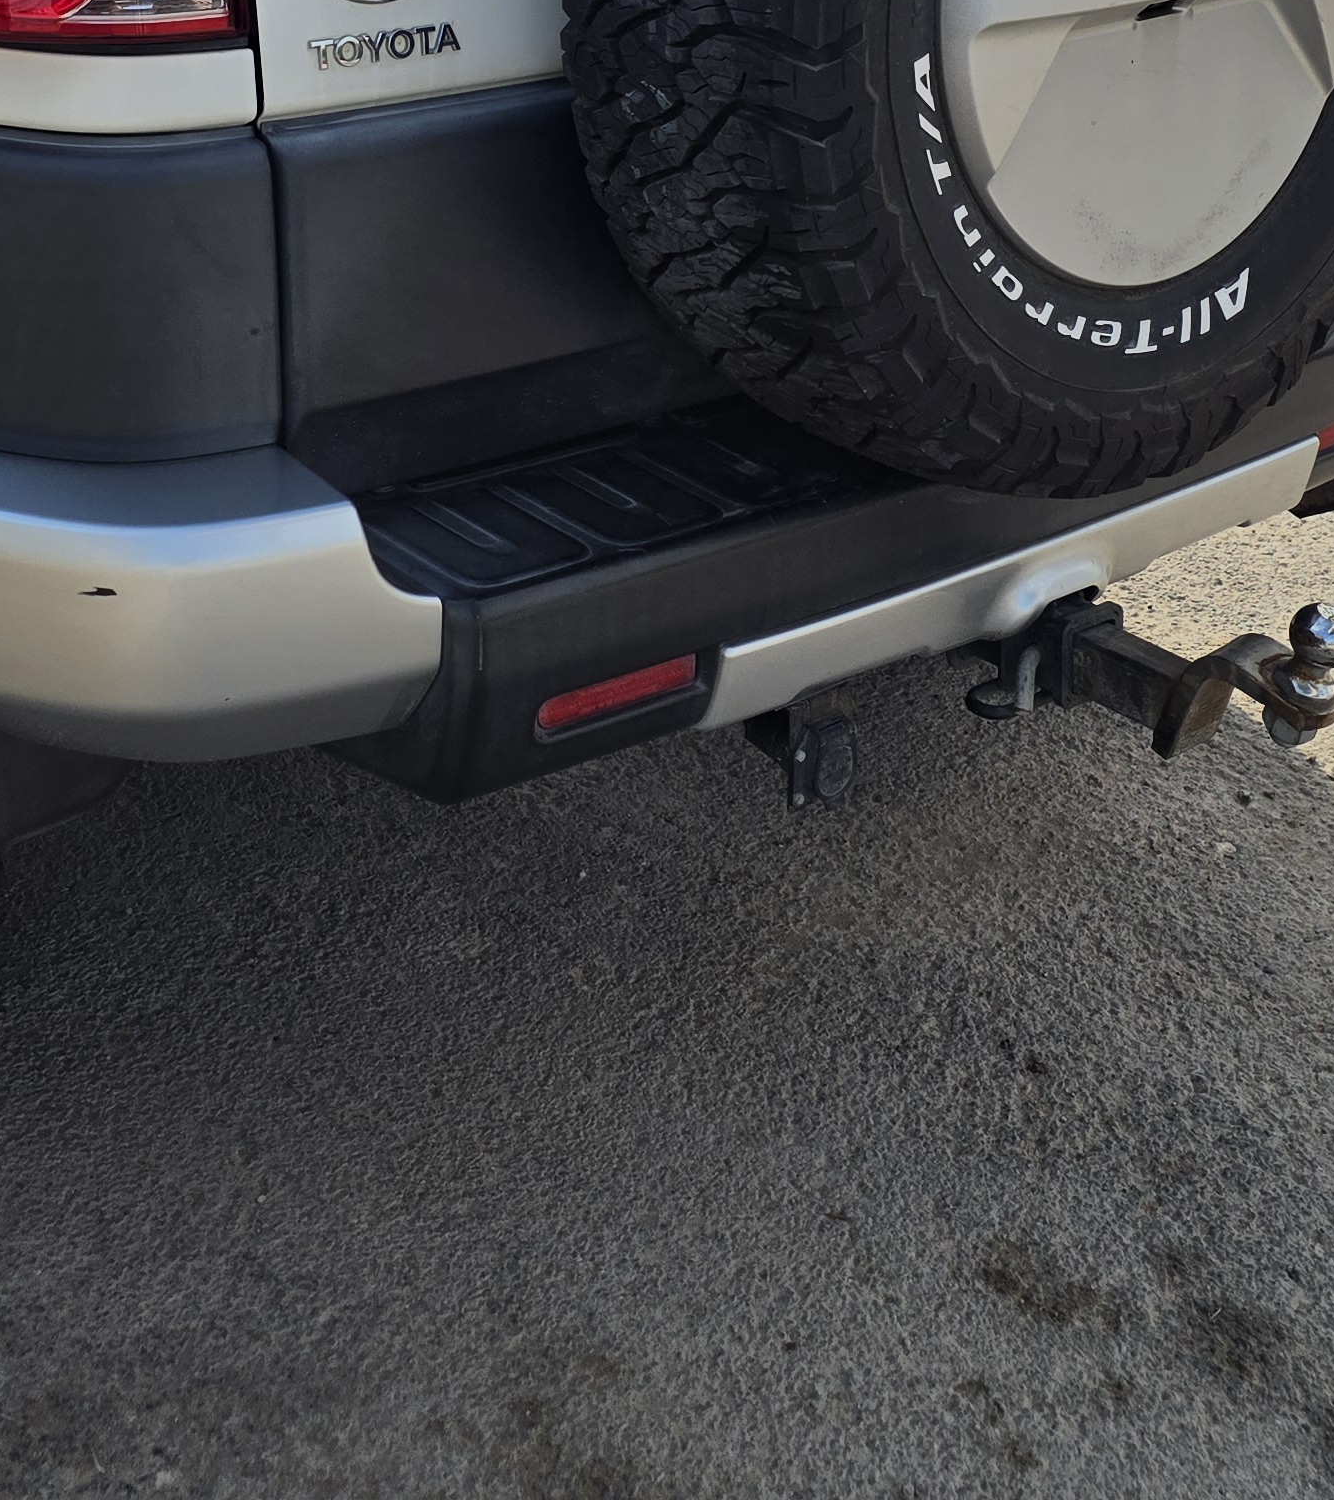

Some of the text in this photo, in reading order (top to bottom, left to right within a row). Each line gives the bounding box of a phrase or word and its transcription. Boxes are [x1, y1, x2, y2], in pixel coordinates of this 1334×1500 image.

[308, 22, 462, 71] TOYOTA
[914, 52, 1250, 355] All-Terrain T/A
